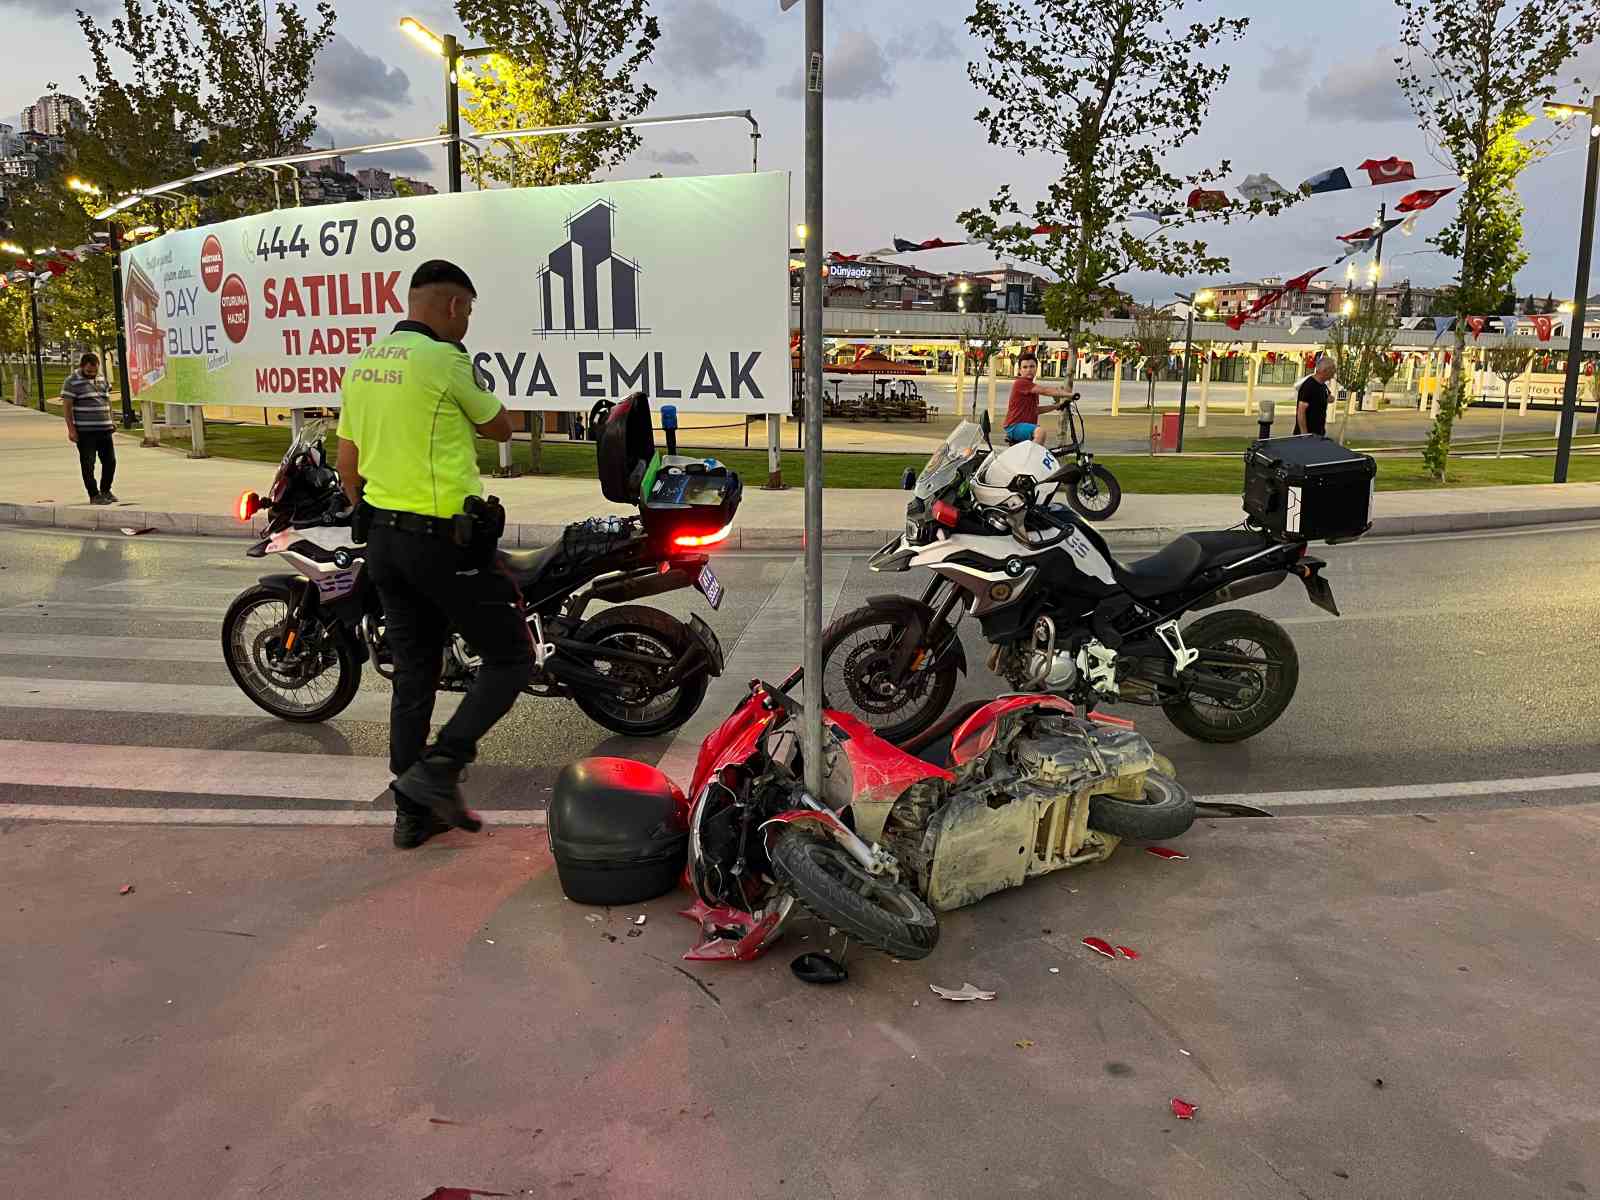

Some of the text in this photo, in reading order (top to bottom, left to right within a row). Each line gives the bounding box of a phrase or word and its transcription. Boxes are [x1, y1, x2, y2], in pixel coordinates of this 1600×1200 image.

[257, 214, 416, 261] 444 67 08
[830, 265, 872, 278] Dünyagöz
[165, 286, 199, 318] DAY
[264, 270, 404, 319] SATILIK
[168, 325, 218, 355] BLUE
[282, 327, 377, 356] 11 ADET
[473, 351, 764, 400] SYA EMLAK
